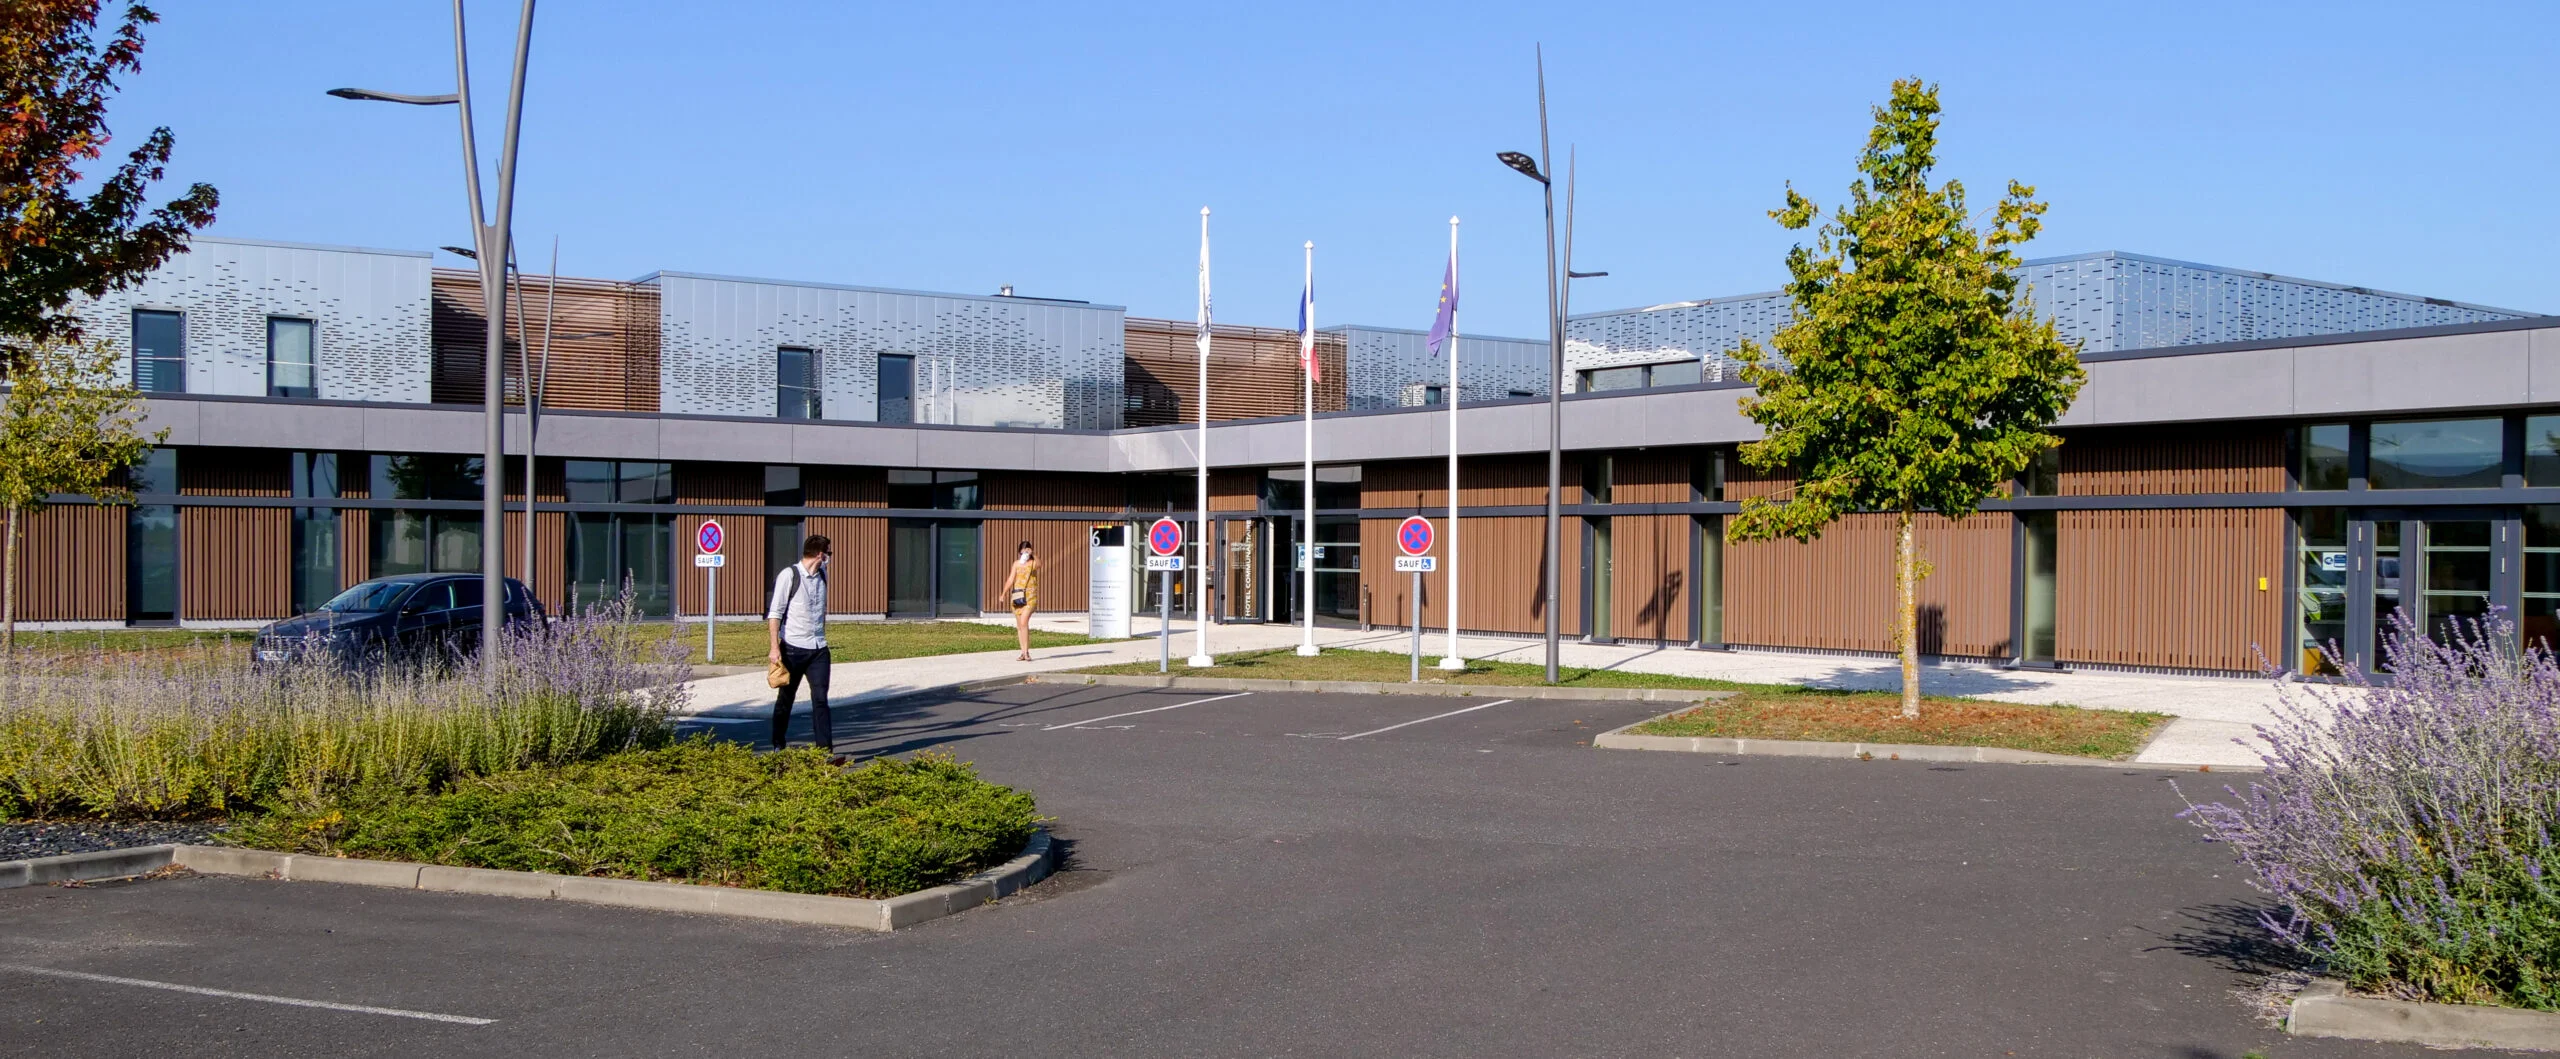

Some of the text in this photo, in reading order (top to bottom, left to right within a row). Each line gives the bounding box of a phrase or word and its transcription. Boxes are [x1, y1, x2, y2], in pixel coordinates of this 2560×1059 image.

[1092, 530, 1101, 547] 6
[1149, 559, 1169, 567] SAUF
[1397, 559, 1419, 567] SAUF
